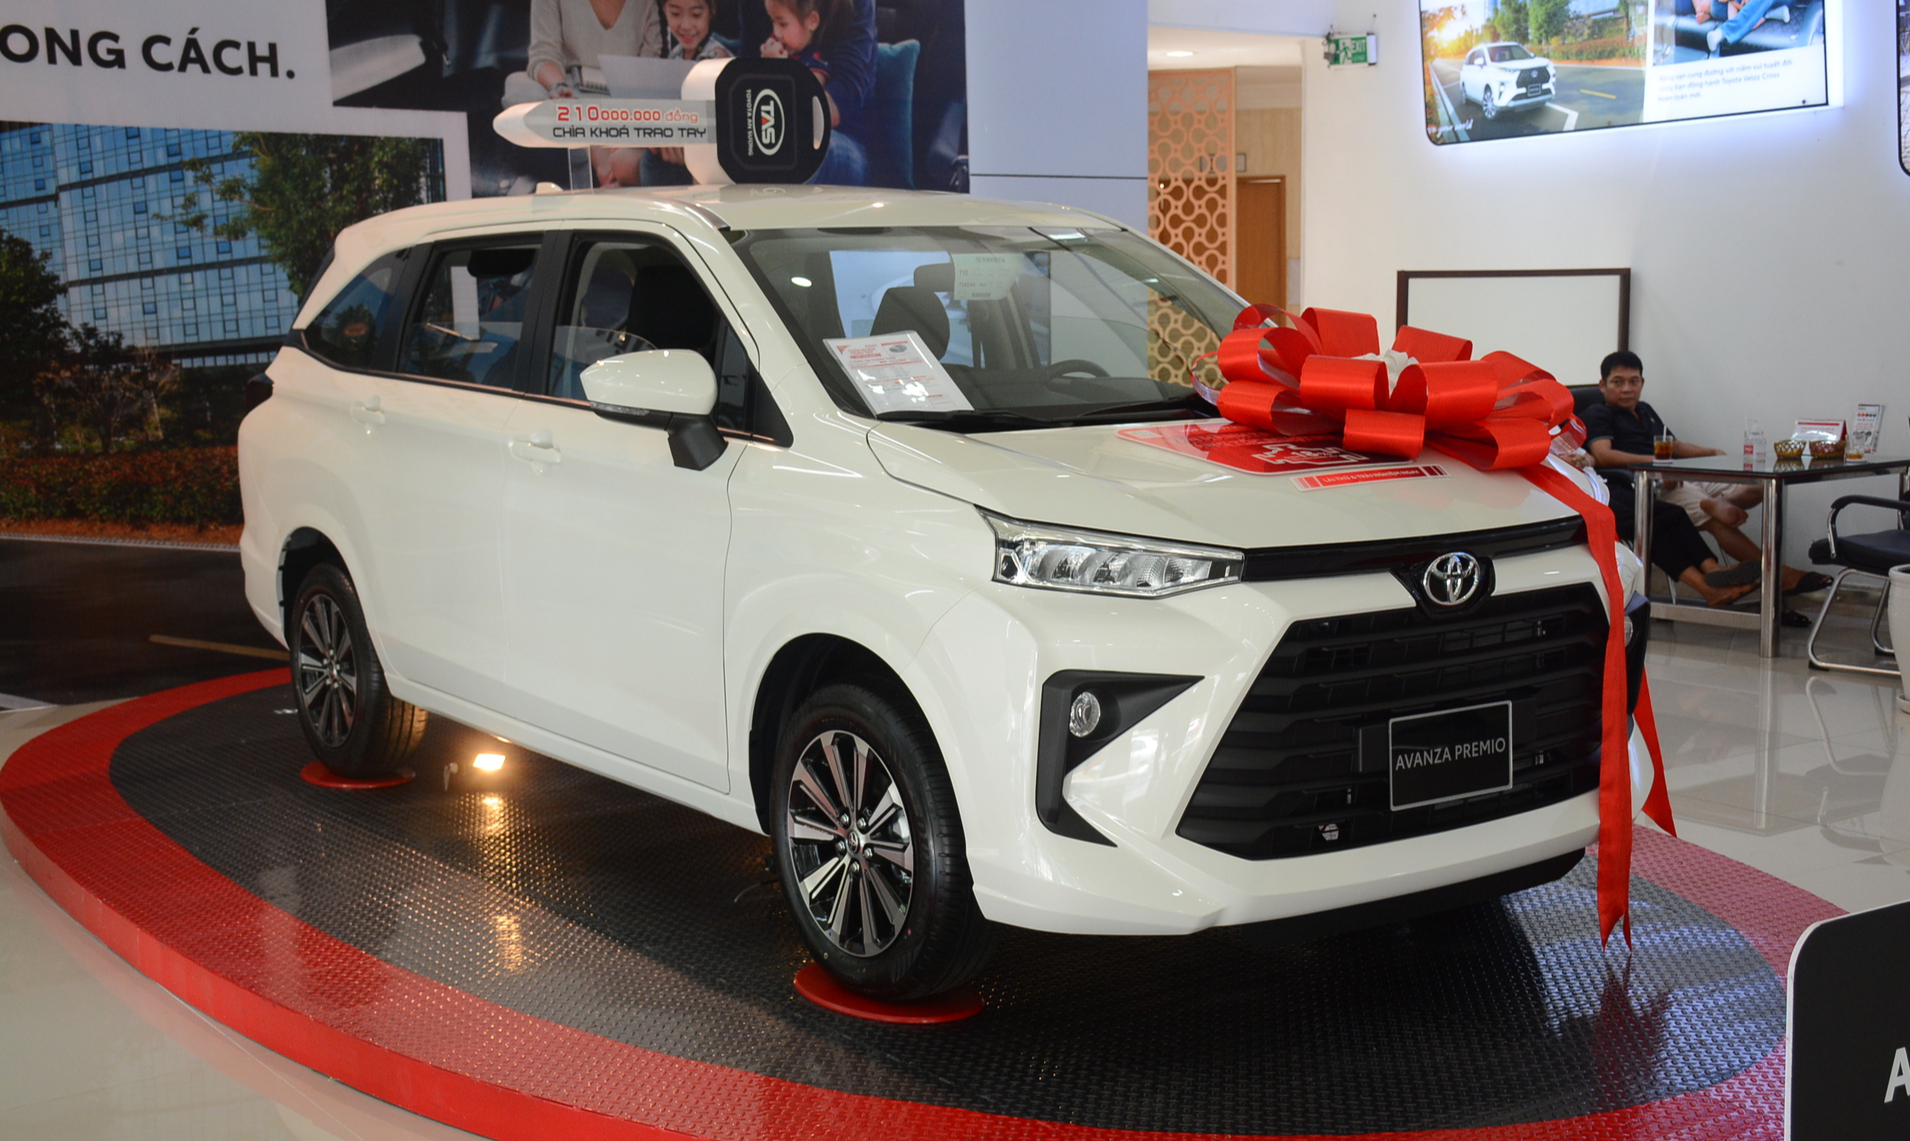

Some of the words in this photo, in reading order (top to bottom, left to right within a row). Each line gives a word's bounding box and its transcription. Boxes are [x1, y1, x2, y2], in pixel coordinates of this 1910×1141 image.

[0, 24, 127, 69] ONG
[141, 27, 296, 80] CÁCH.
[1721, 77, 1742, 86] Toyota
[1743, 74, 1761, 82] Veloz
[1762, 72, 1780, 80] Cross
[552, 125, 586, 138] CHÌA
[590, 125, 630, 138] KHOÁ
[633, 127, 674, 138] TRAO
[678, 127, 707, 138] TAY
[761, 100, 776, 144] TAS
[1395, 746, 1452, 771] AVANZA
[1455, 737, 1506, 760] PREMIO
